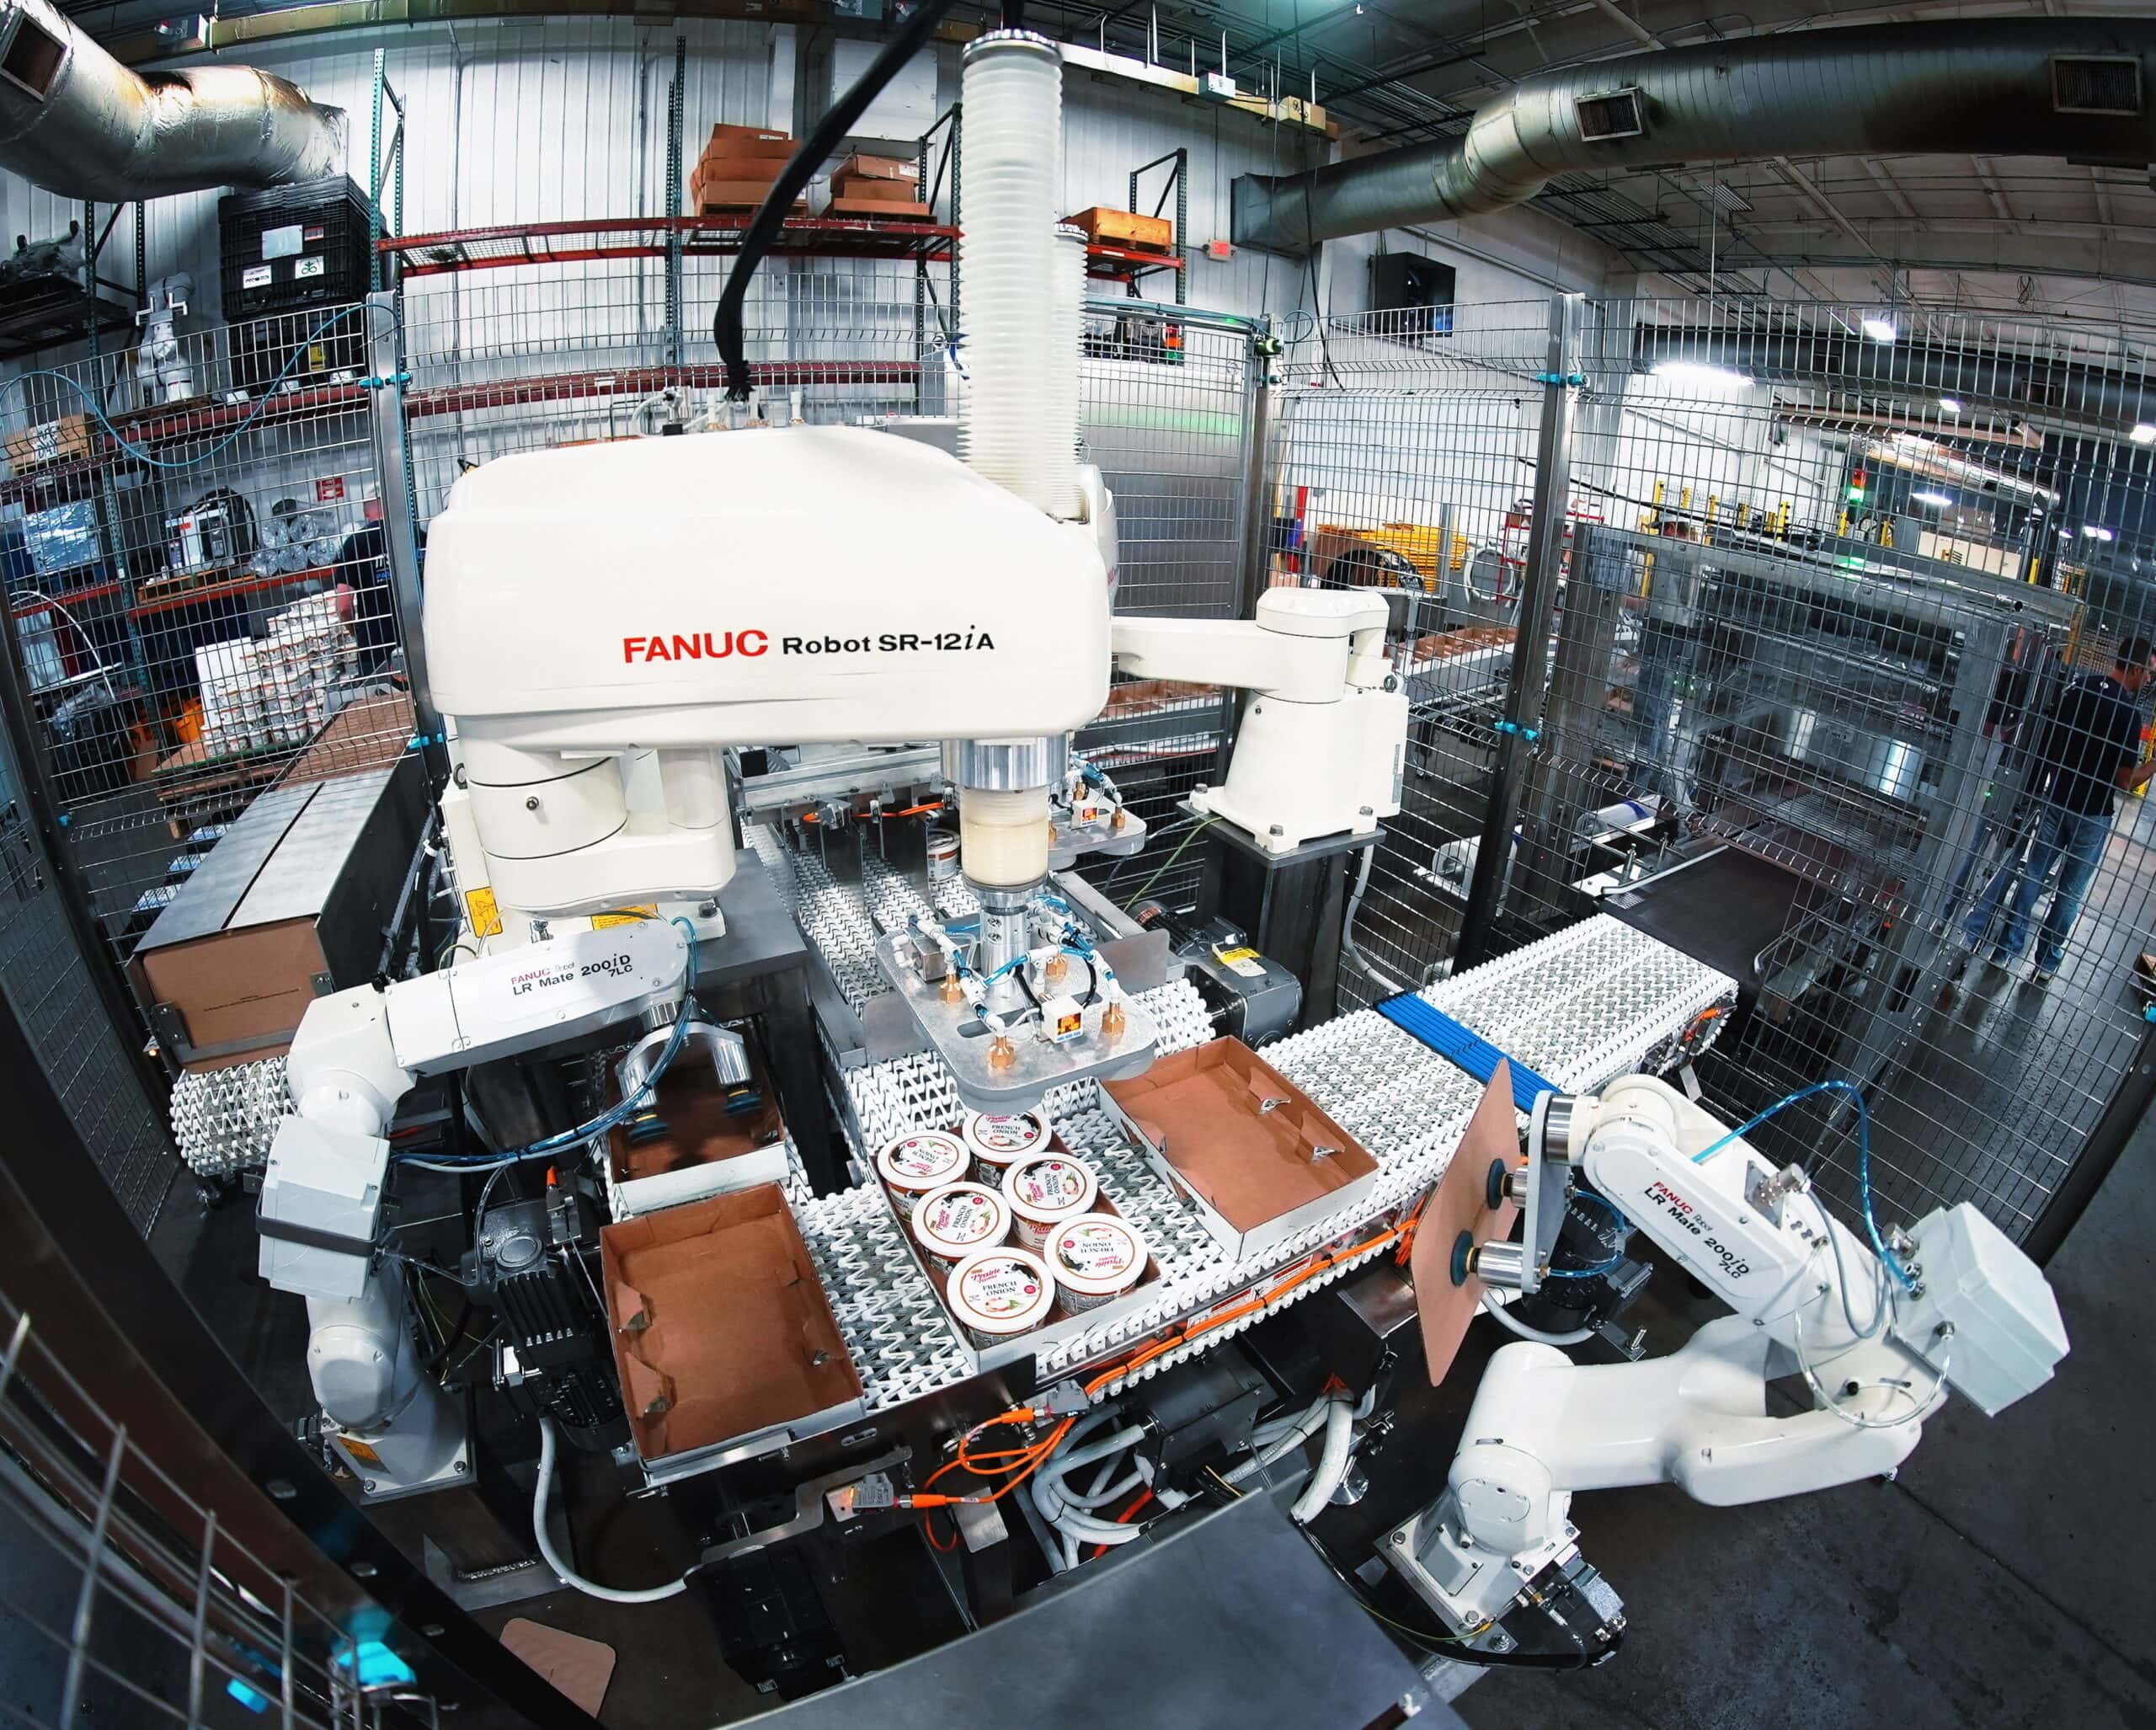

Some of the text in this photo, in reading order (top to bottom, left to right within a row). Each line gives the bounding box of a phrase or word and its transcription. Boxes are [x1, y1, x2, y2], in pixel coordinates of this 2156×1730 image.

[623, 624, 995, 663] FANUC Robot SR-12iA
[510, 969, 551, 985] FANUC
[513, 953, 631, 996] LR Mate 200iD
[608, 964, 632, 978] 7LC
[1044, 1173, 1054, 1195] FRENCH
[1052, 1174, 1060, 1194] ONION
[1652, 1181, 1694, 1214] FANUC
[953, 1204, 968, 1228] FRENCH
[960, 1208, 974, 1228] ONION
[1644, 1187, 1749, 1274] LR Mate 200iD
[1719, 1259, 1742, 1279] 7LC
[982, 1280, 1017, 1291] FRENCH
[986, 1287, 1016, 1296] ONION
